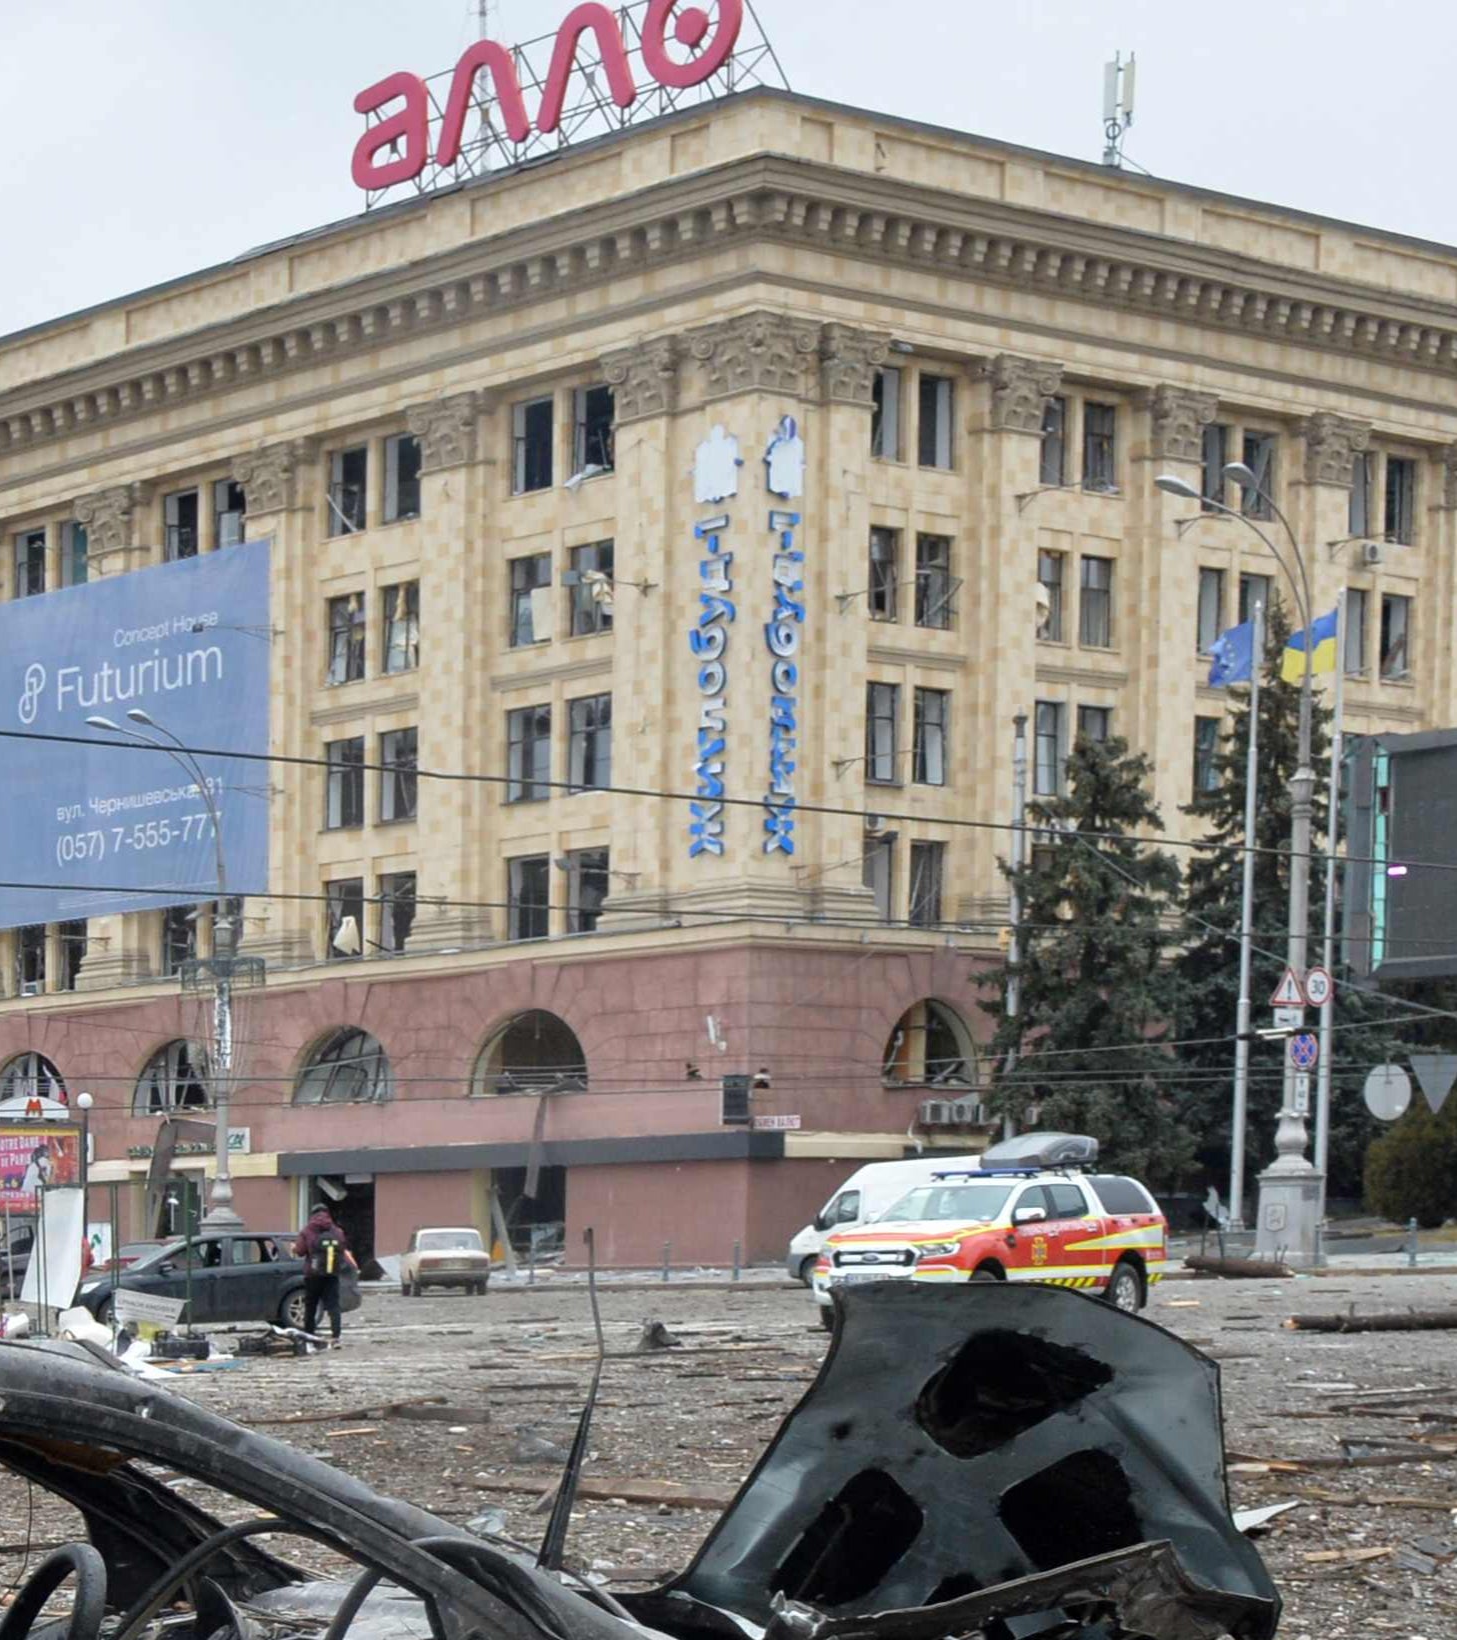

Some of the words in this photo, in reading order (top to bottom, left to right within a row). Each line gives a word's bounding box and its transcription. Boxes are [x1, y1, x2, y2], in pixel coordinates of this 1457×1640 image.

[113, 621, 170, 648] Concept
[173, 611, 219, 634] House
[57, 646, 223, 711] Futurium
[56, 803, 85, 823] вул.
[56, 830, 104, 866] (057)
[112, 811, 223, 853] 7-555-777
[1311, 980, 1326, 994] 30
